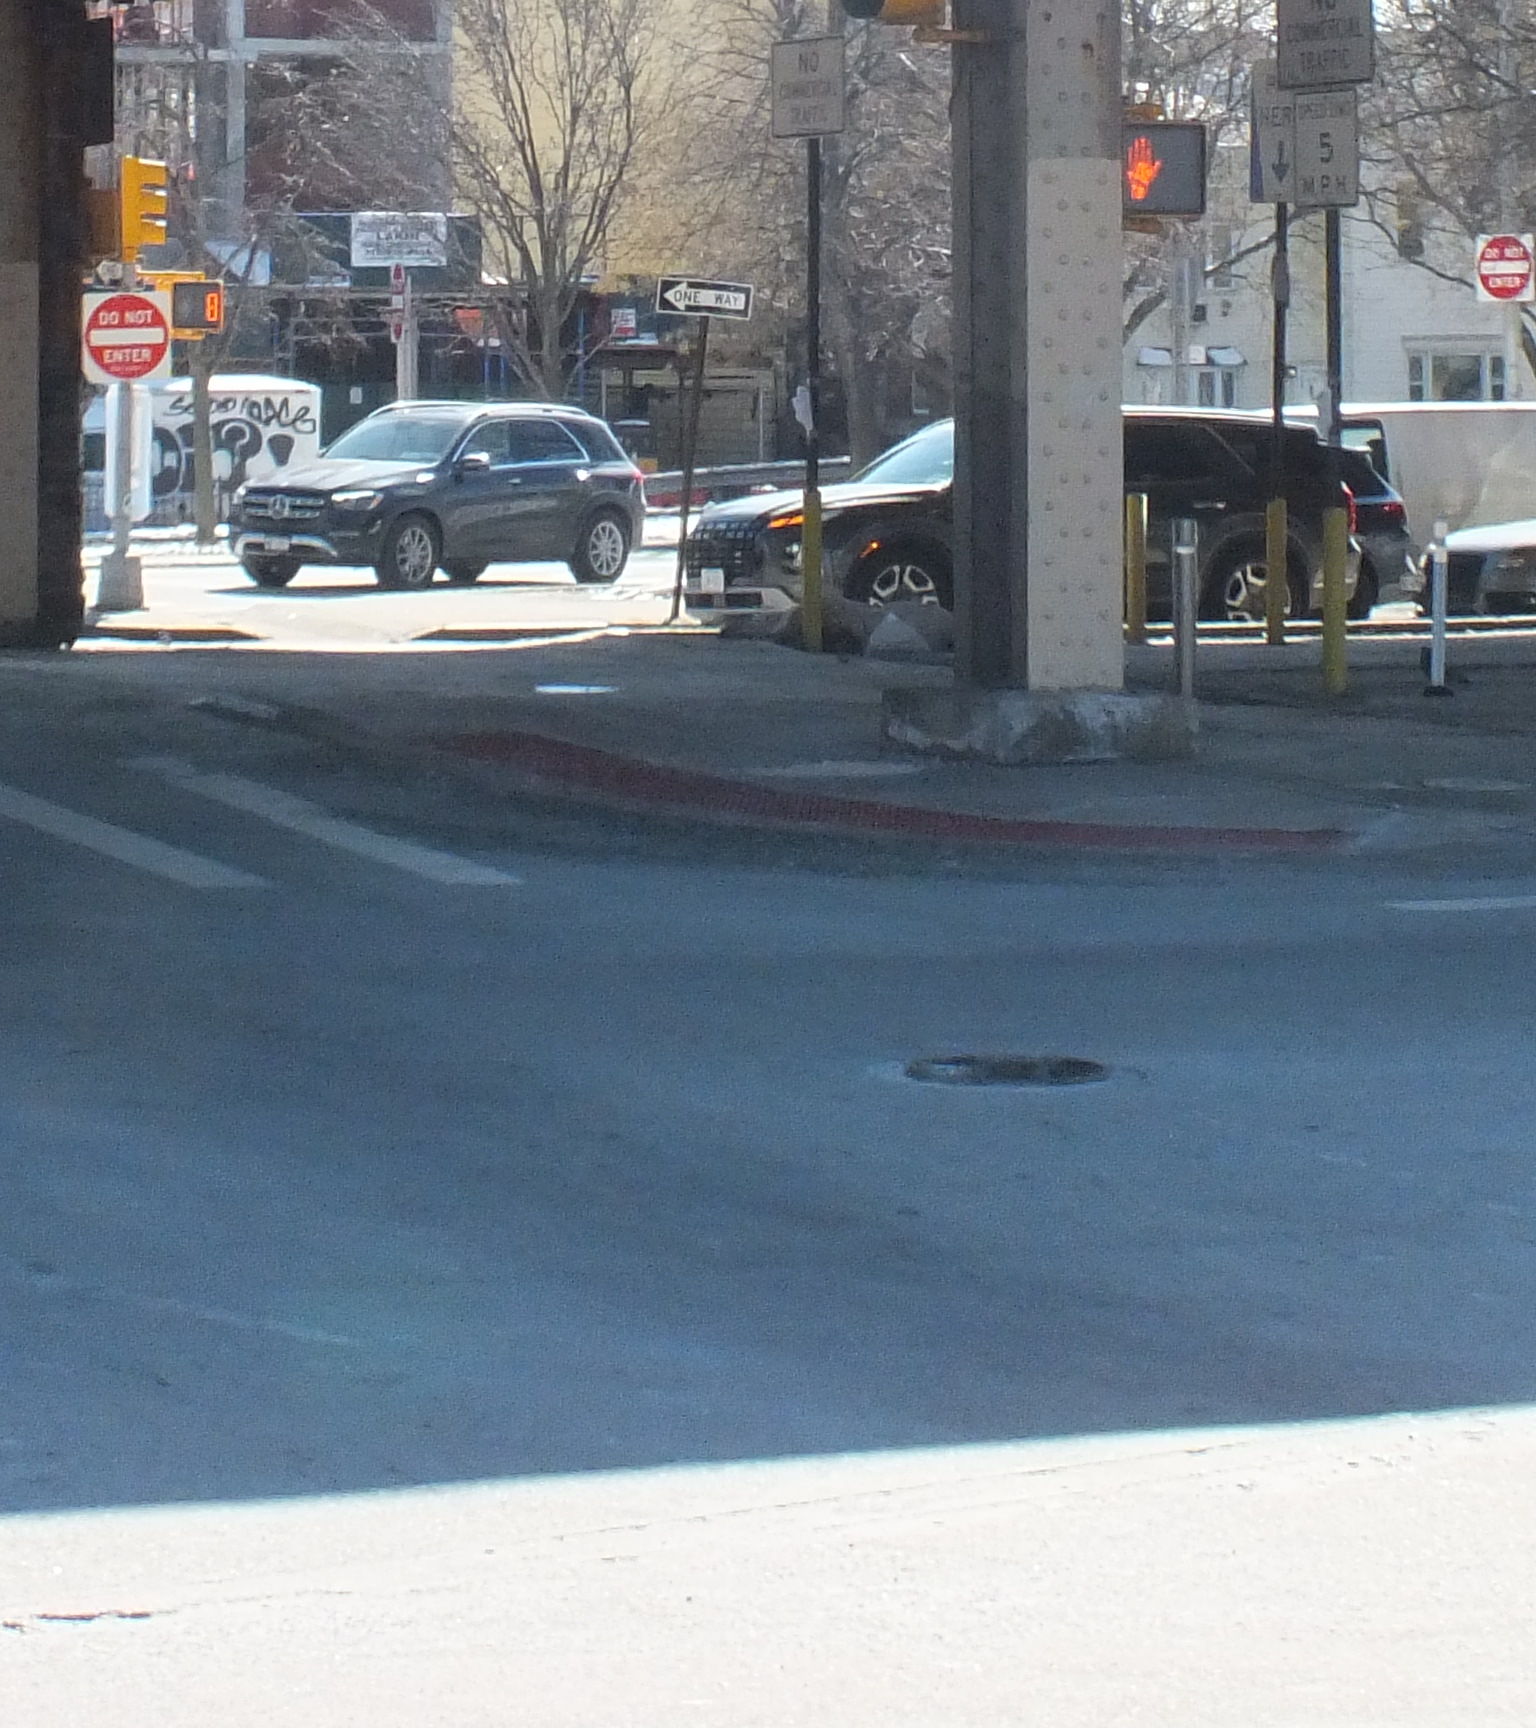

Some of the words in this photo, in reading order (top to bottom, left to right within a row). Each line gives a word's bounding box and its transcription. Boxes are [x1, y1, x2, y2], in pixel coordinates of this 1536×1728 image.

[797, 51, 820, 74] NO
[1319, 132, 1334, 164] 5
[1301, 174, 1348, 197] MPH
[673, 289, 702, 304] ONE
[714, 293, 741, 307] WAY
[98, 311, 120, 326] DO
[124, 309, 154, 325] NOT
[102, 347, 153, 365] ENTER
